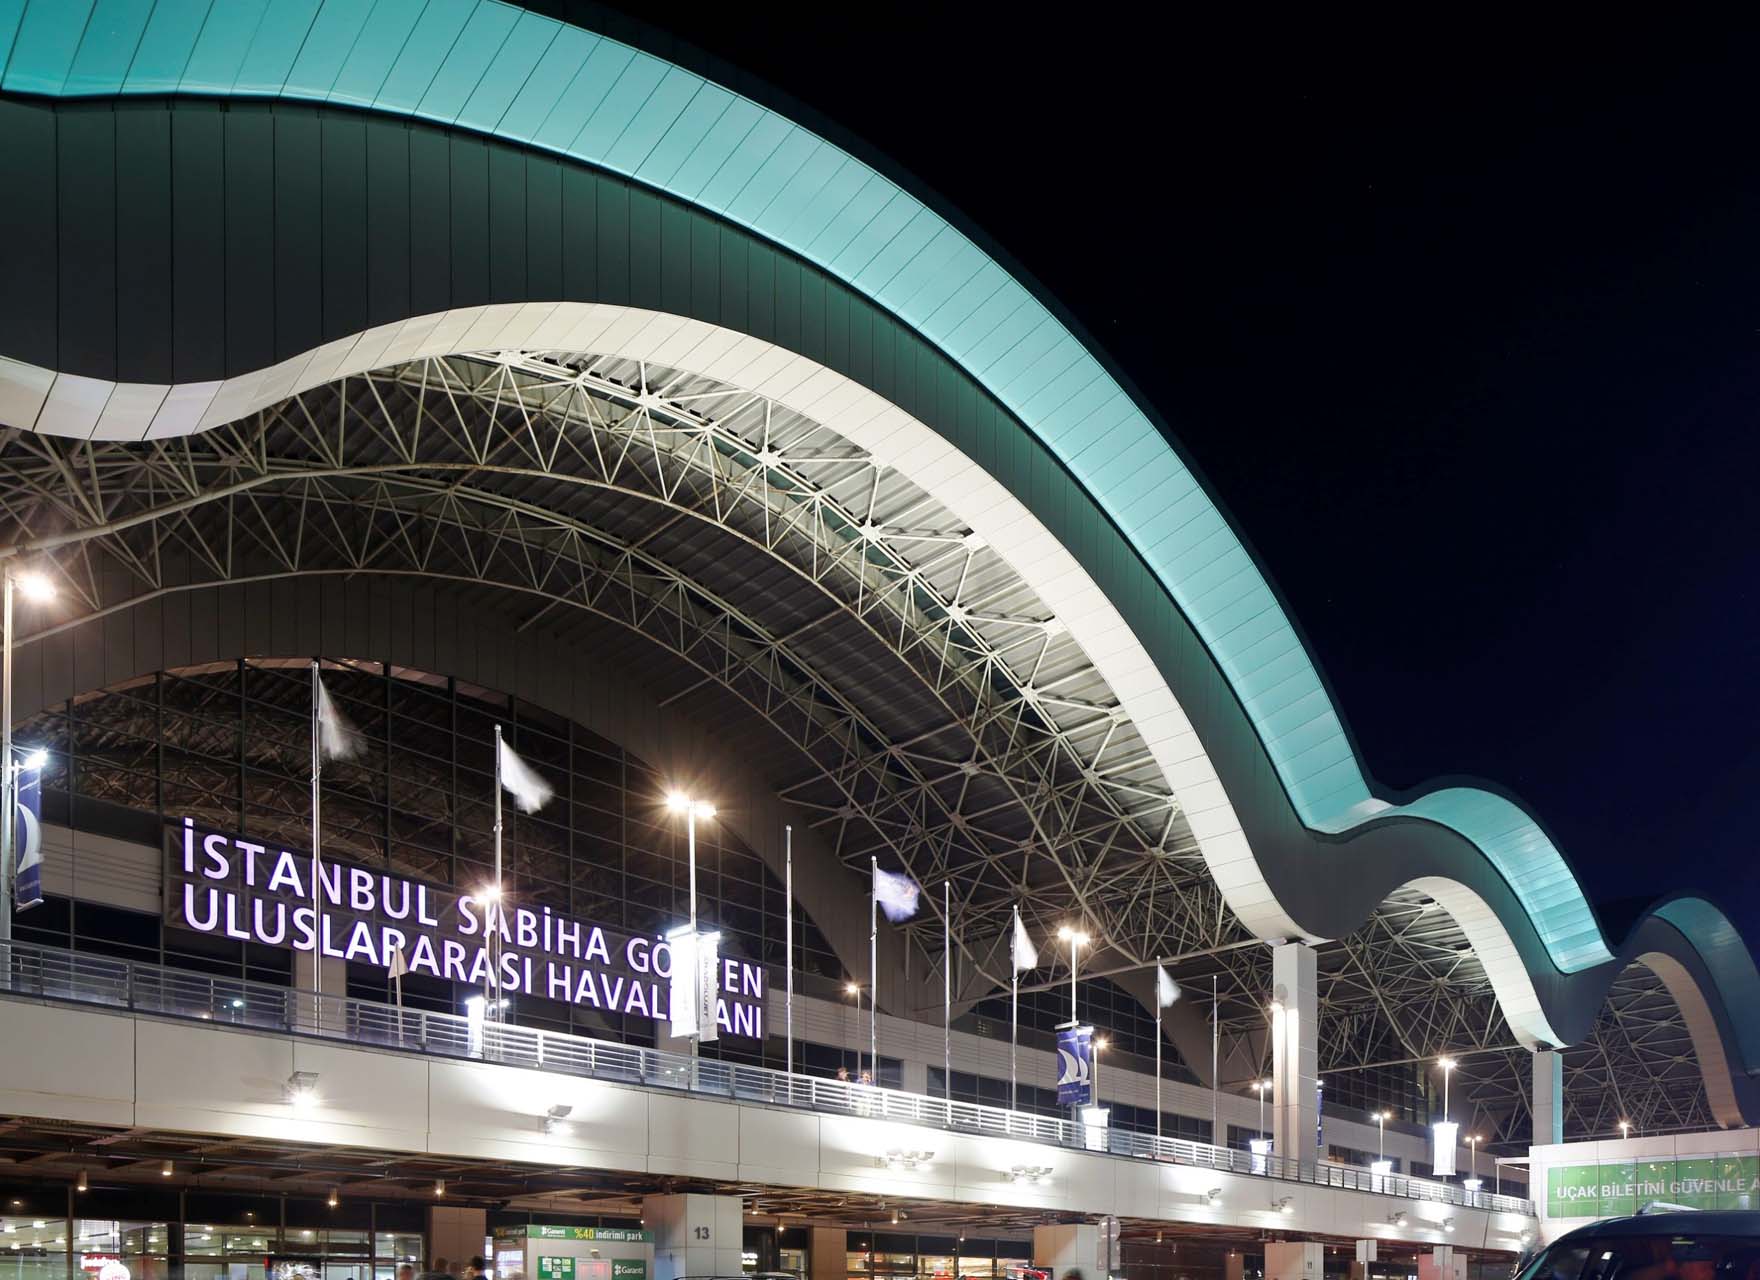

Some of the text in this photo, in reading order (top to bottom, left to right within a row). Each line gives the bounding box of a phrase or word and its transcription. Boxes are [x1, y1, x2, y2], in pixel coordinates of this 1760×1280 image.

[184, 817, 762, 999] İSTANBUL SABİHA GÖEN
[184, 883, 762, 1039] ULUSLARARASI HAVALANI
[1557, 1185, 1598, 1201] UÇAK
[1602, 1179, 1665, 1198] BİLETİNİ
[1669, 1178, 1747, 1195] GÜVENLE
[574, 1228, 594, 1240] %40
[595, 1230, 625, 1240] indirimli
[627, 1232, 643, 1241] park
[694, 1226, 710, 1240] 13
[621, 1266, 644, 1275] Garanti
